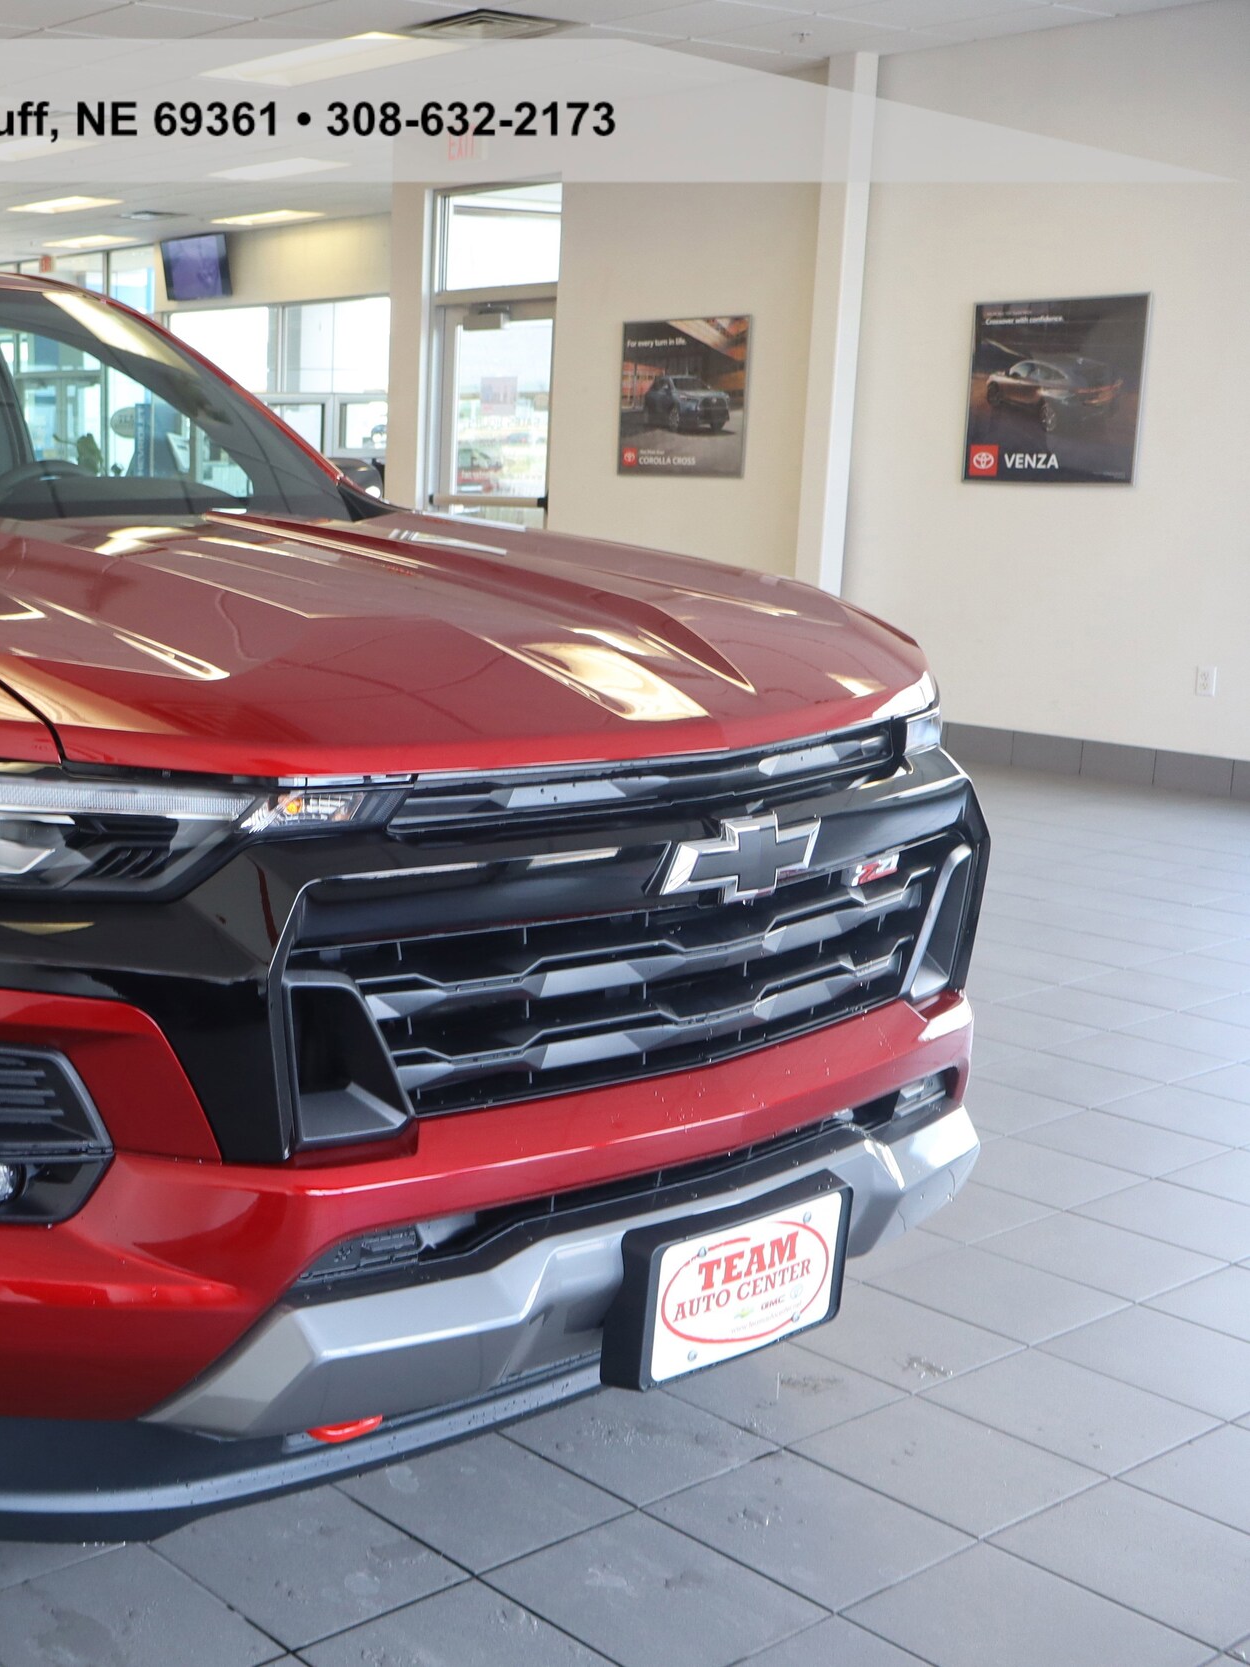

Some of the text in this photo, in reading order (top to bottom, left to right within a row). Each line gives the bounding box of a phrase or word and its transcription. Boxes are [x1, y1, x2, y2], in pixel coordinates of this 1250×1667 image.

[627, 340, 637, 348] For
[638, 340, 653, 349] every
[655, 339, 668, 347] turn
[669, 338, 675, 346] in
[638, 456, 697, 466] COROLLA CROSS
[1004, 453, 1059, 469] VENZA
[698, 1231, 798, 1291] TEAM
[673, 1258, 812, 1323] AUTO CENTER
